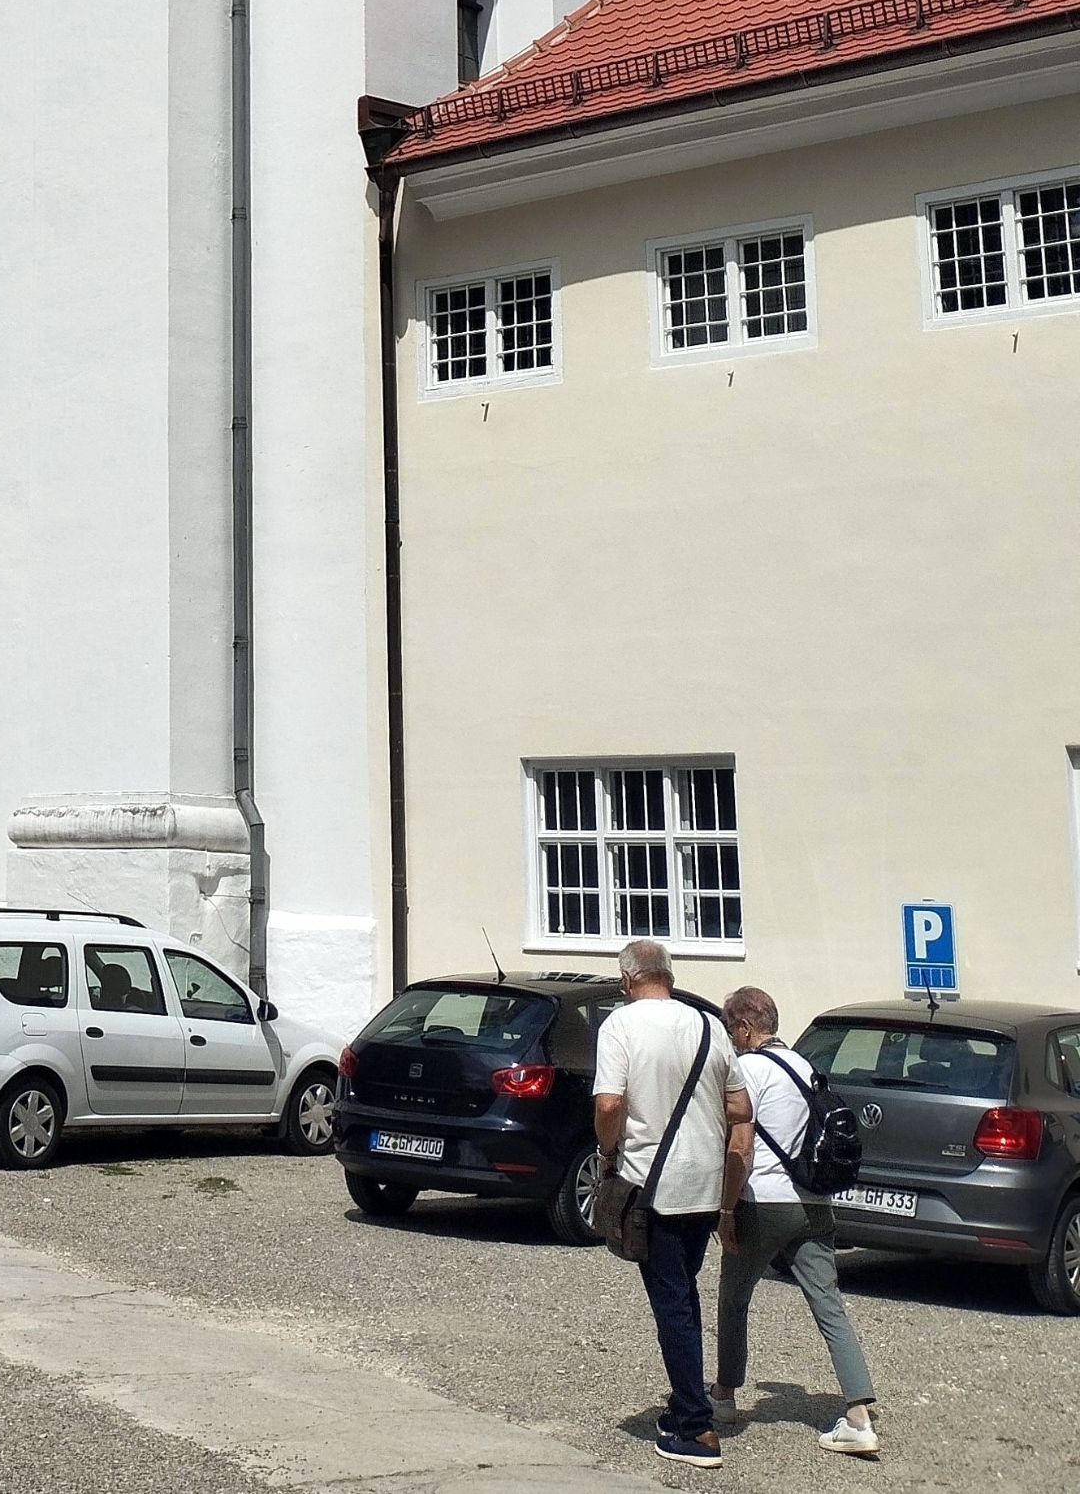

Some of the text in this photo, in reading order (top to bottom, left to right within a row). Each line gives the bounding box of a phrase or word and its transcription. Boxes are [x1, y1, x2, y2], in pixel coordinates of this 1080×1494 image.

[913, 910, 943, 959] P
[379, 1133, 391, 1148] GZ
[414, 1137, 442, 1155] 2000
[864, 1188, 884, 1206] GH
[886, 1192, 914, 1210] 333
